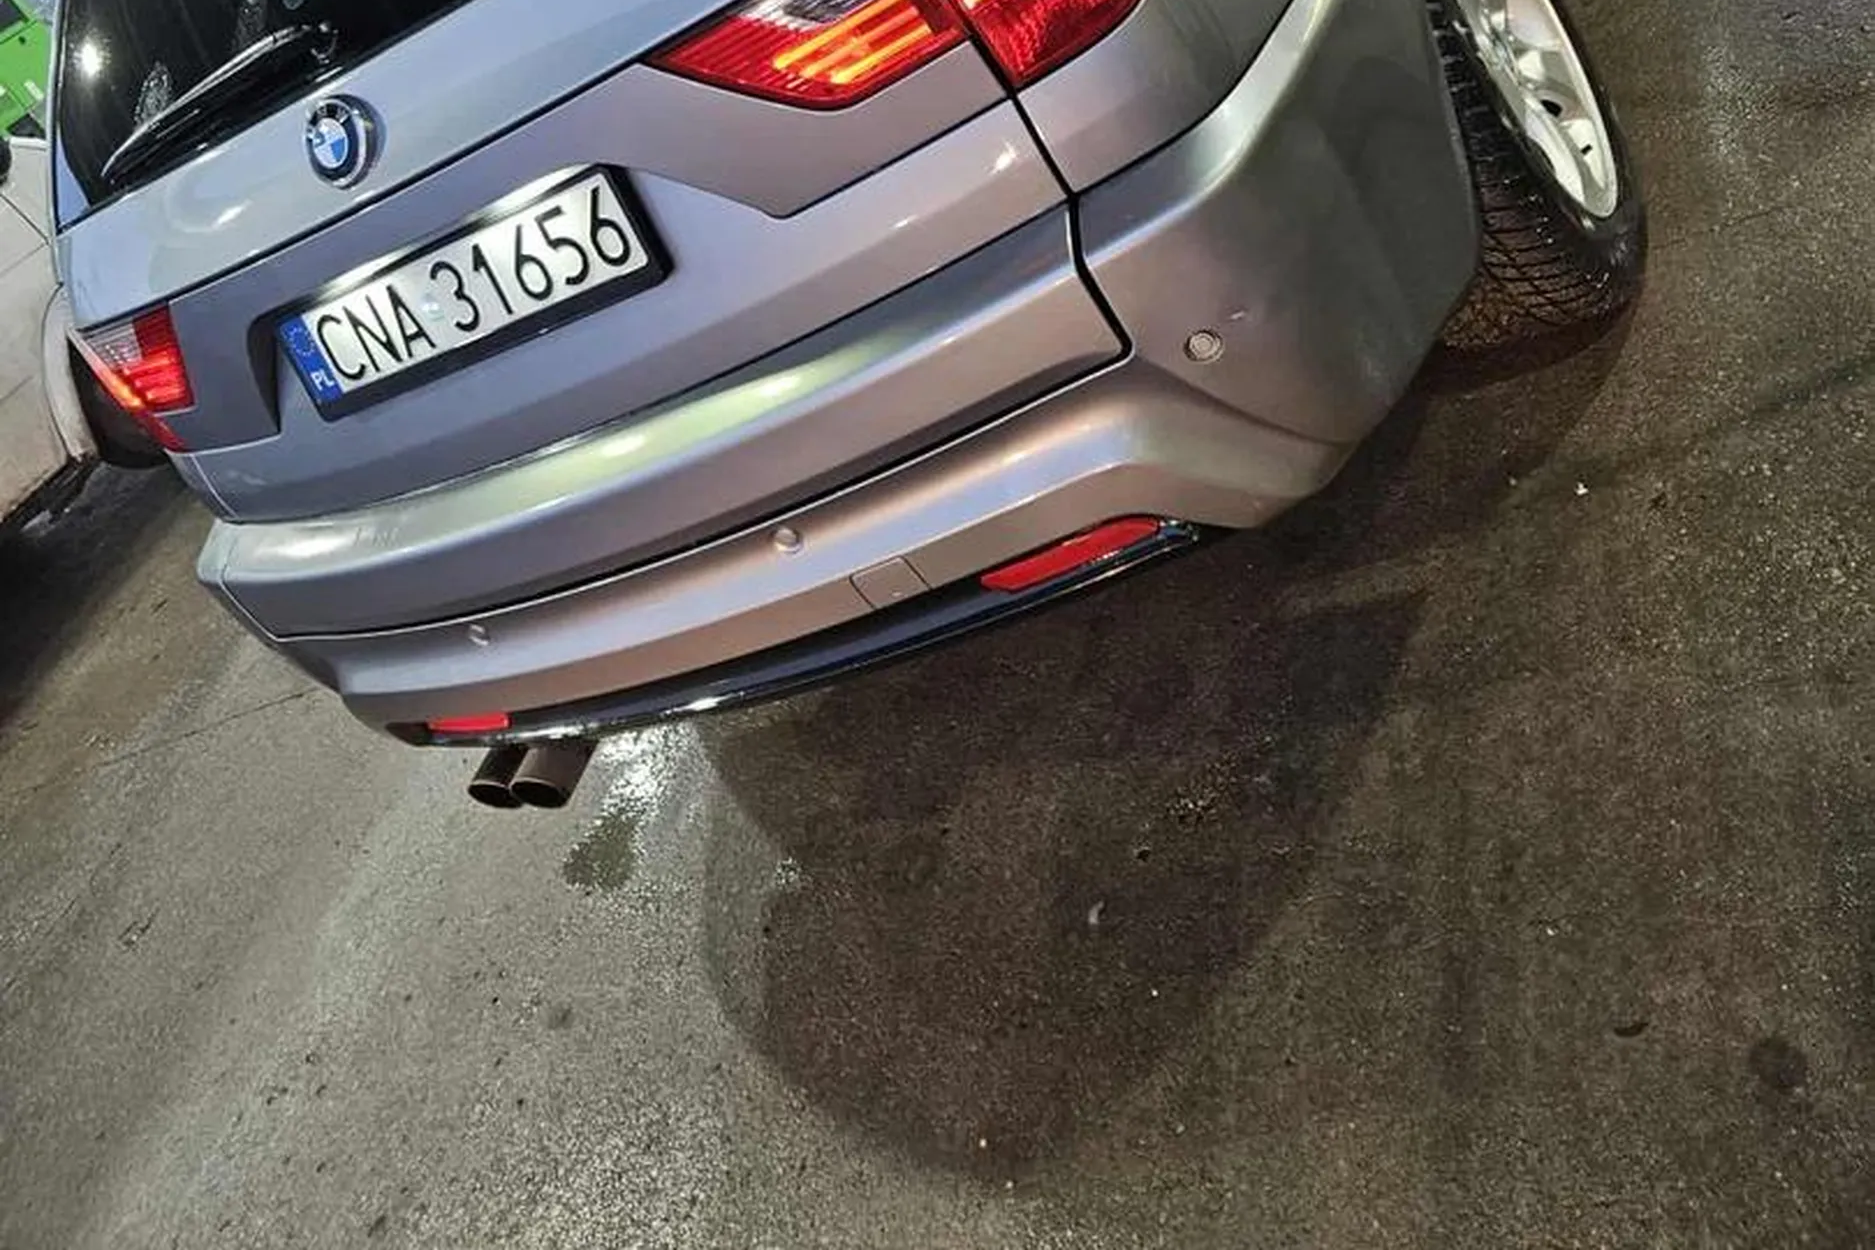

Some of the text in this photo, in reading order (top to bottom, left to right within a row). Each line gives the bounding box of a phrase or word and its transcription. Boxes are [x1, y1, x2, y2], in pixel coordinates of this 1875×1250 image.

[316, 186, 631, 381] CNA 31656
[310, 369, 335, 391] PL
